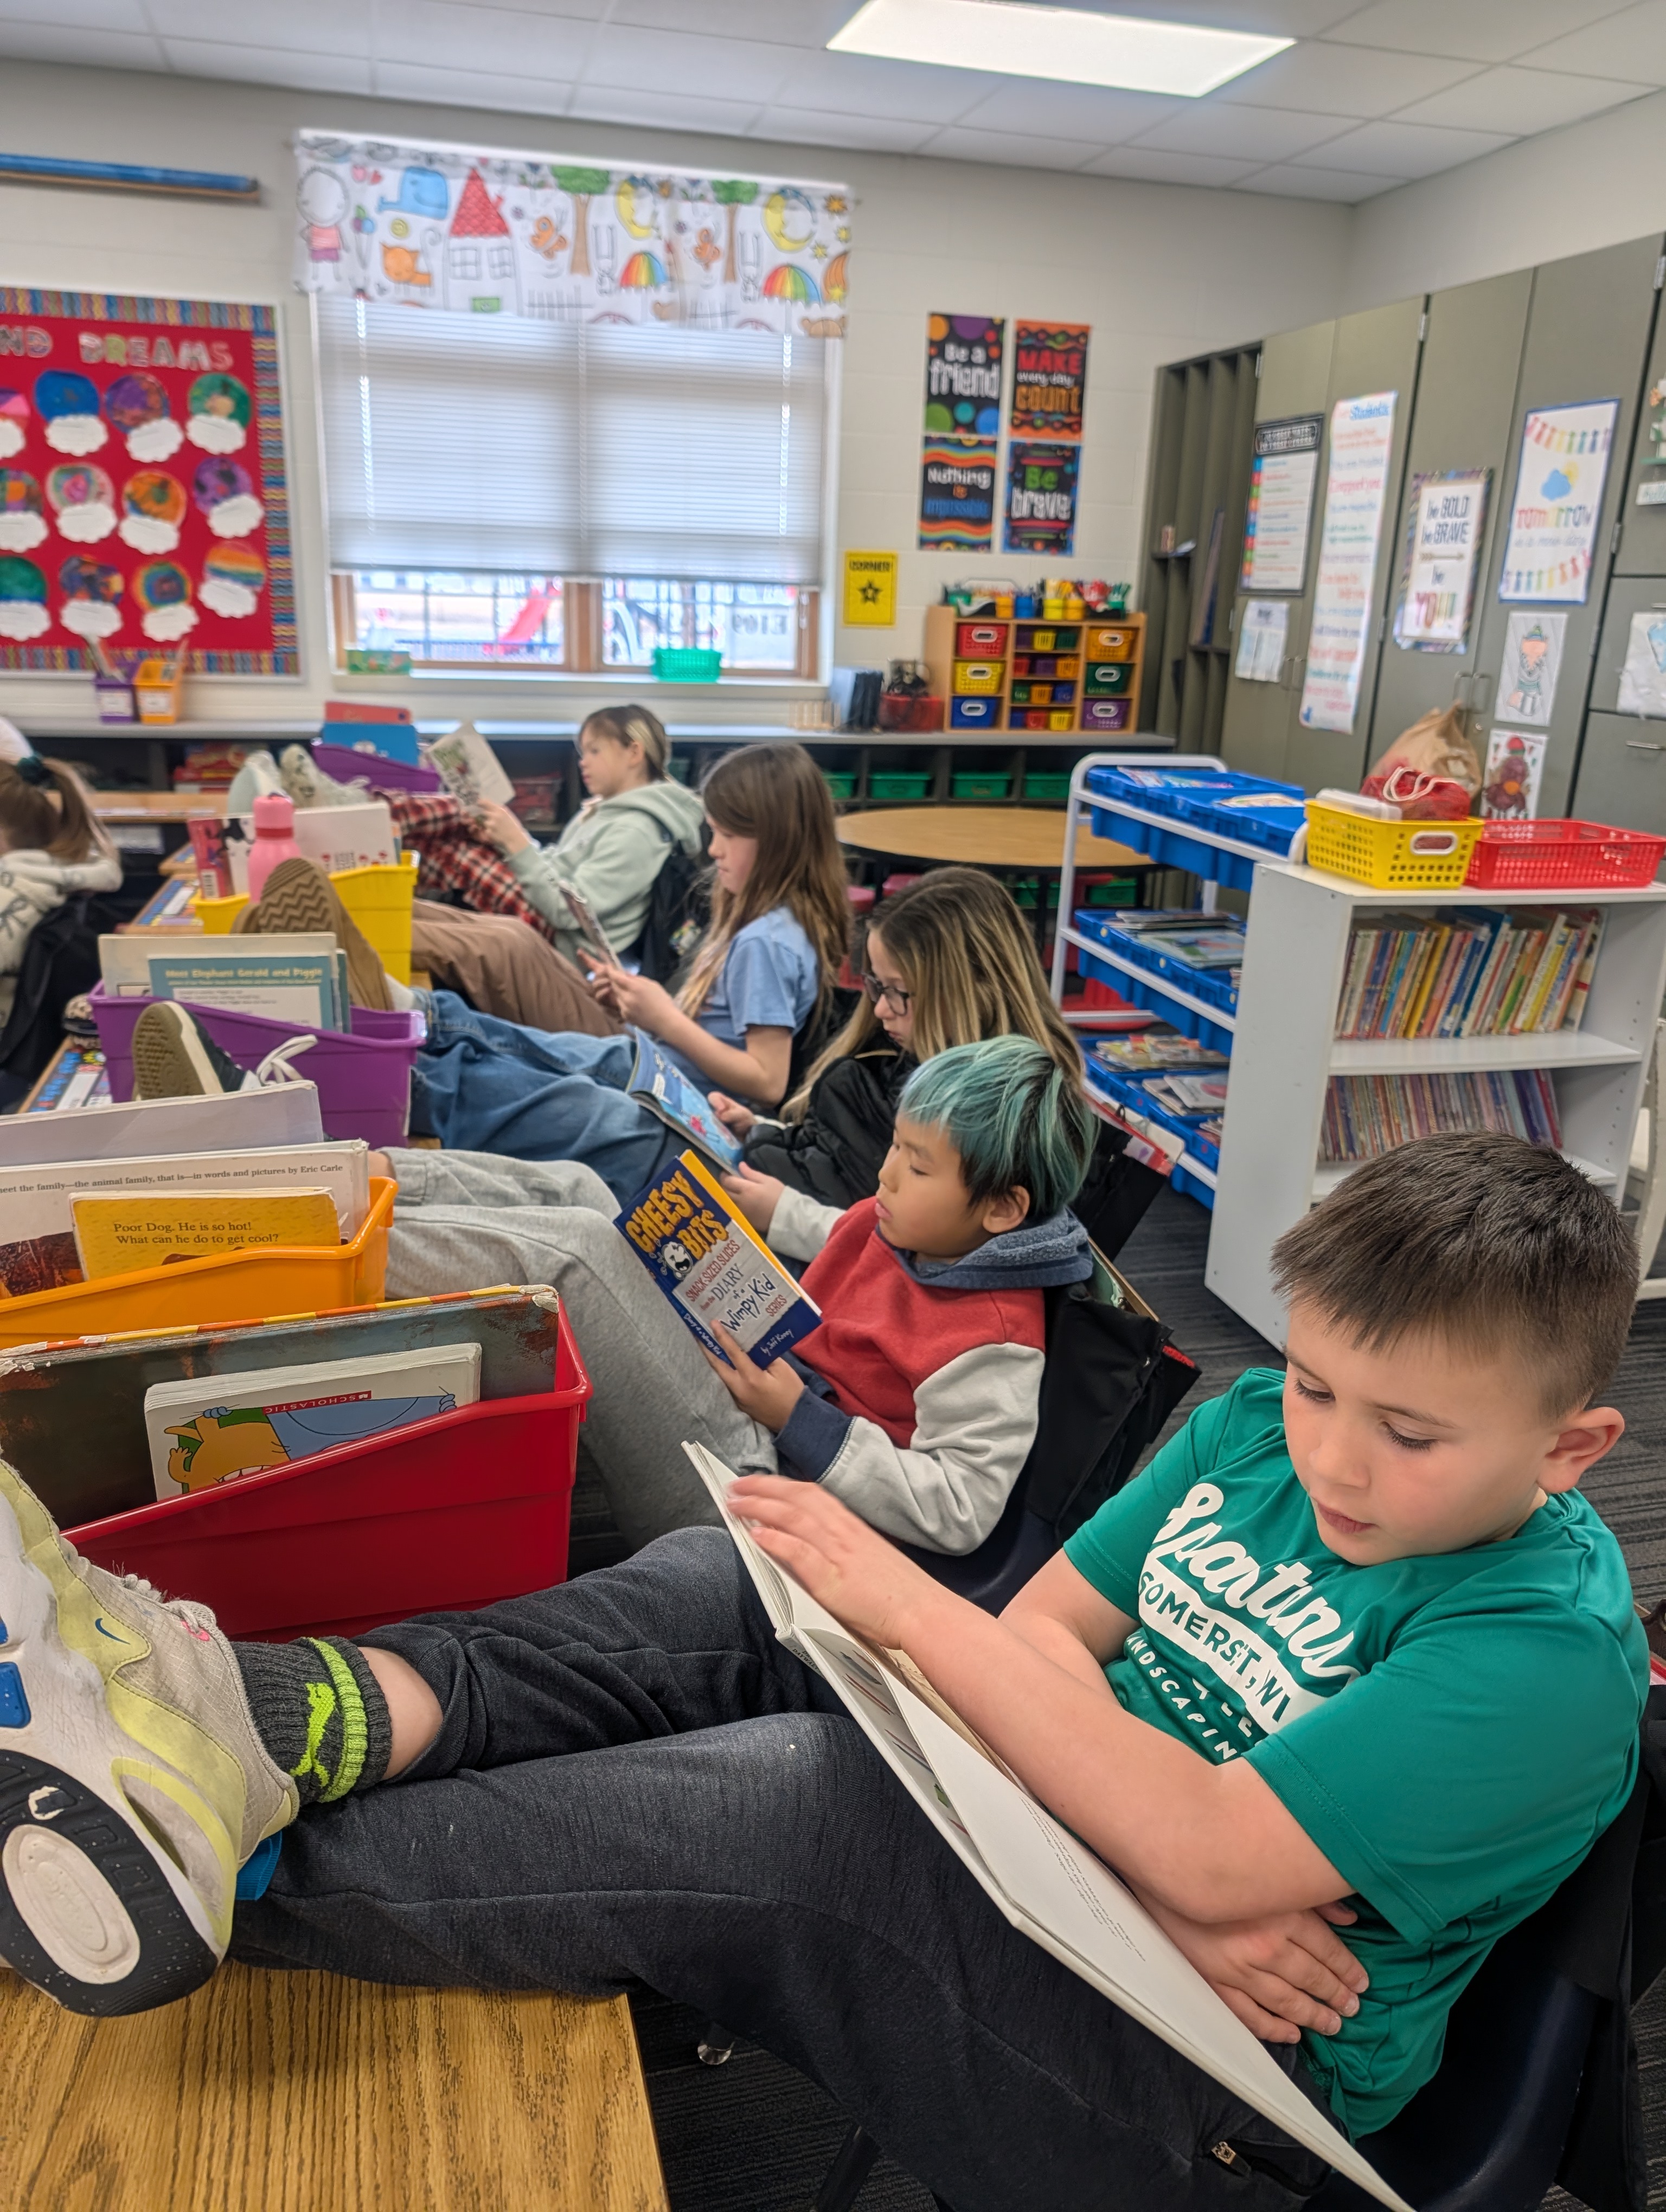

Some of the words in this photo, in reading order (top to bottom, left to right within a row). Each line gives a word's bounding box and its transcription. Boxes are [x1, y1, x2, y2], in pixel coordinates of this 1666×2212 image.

[78, 331, 234, 371] DREAMS
[945, 343, 969, 362] Be
[971, 346, 986, 364] a
[1018, 349, 1082, 375] MAKE
[930, 357, 1000, 400] friend
[928, 467, 991, 490] Nothing
[1025, 465, 1058, 491] Be
[1011, 486, 1071, 520] brave
[1440, 496, 1470, 519] BOLD
[1433, 521, 1470, 544] BRAVE
[849, 561, 891, 572] CORNER
[192, 968, 234, 979] Elephant
[237, 968, 269, 978] Gerald
[92, 1178, 123, 1187] animal
[125, 1175, 156, 1185] family,
[157, 1174, 175, 1182] that
[204, 1170, 231, 1179] words
[233, 1169, 249, 1177] and
[251, 1167, 286, 1178] pictures
[288, 1166, 298, 1175] by
[300, 1165, 318, 1173] Eric
[321, 1164, 343, 1172] Carle
[625, 1170, 704, 1254] CHEESY
[114, 1223, 142, 1232] Poor
[146, 1222, 175, 1234] Dog.
[178, 1222, 196, 1231] He
[200, 1222, 209, 1231] is
[228, 1222, 252, 1231] hot!
[116, 1235, 148, 1244] What
[176, 1235, 190, 1244] he
[193, 1235, 208, 1244] do
[212, 1235, 224, 1243] to
[227, 1235, 245, 1245] get
[248, 1233, 279, 1243] cool?
[677, 1209, 729, 1260] BITS
[717, 1239, 740, 1266] SLICES
[710, 1263, 745, 1301] DIARY
[720, 1294, 761, 1332] Wimpy
[747, 1272, 777, 1302] Kid
[733, 1290, 740, 1300] of
[765, 1294, 788, 1317] SERIES
[760, 1347, 771, 1356] by
[265, 1395, 356, 1413] SCHOLASTIC
[1139, 1571, 1262, 1689] SOMERST,
